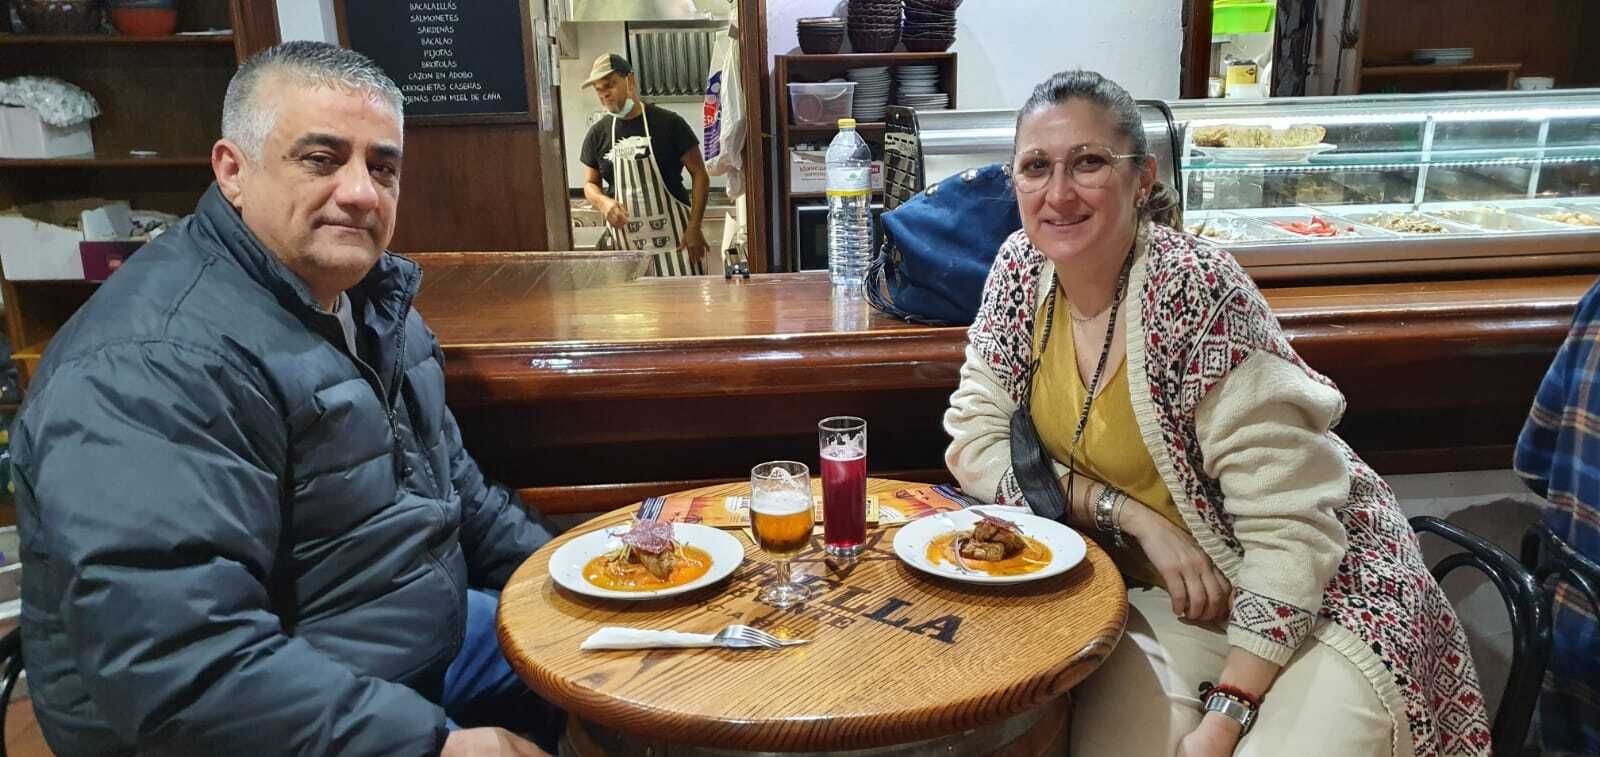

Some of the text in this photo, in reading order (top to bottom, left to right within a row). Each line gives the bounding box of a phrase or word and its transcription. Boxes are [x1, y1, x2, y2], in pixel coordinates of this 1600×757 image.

[410, 14, 459, 23] SALMONETES
[417, 26, 455, 34] SARDINAS
[421, 37, 453, 46] BACALAO
[449, 71, 473, 79] ADOBO
[401, 81, 482, 91] CROQUETAS CASERAS
[432, 94, 447, 102] CON
[449, 93, 468, 101] MIEL
